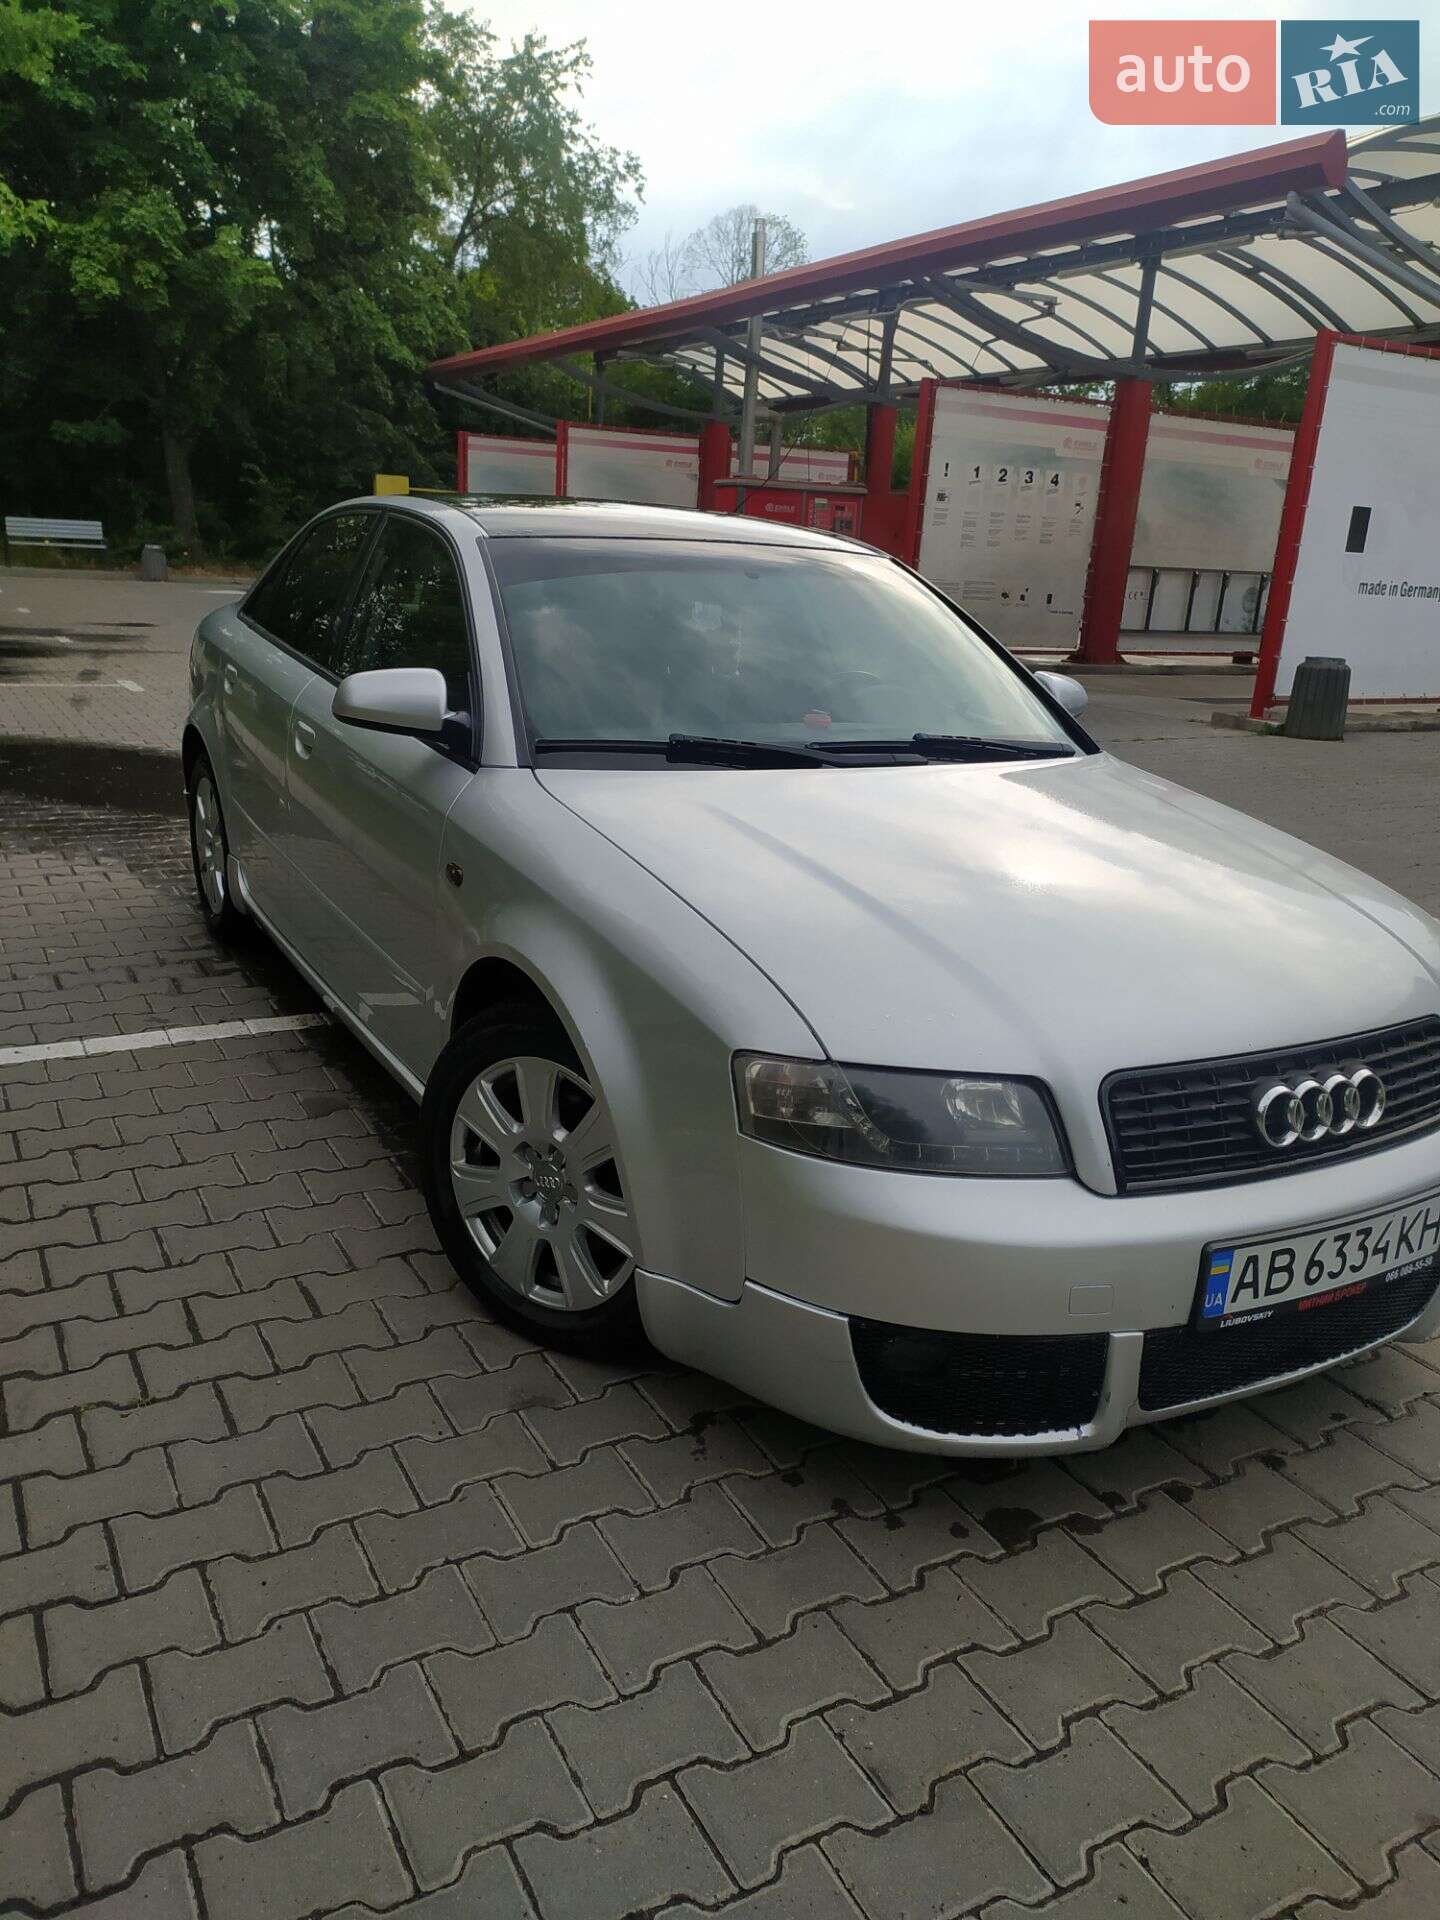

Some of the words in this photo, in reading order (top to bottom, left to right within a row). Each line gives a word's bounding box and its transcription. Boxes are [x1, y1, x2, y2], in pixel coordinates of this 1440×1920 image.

[973, 466, 981, 479] 1
[998, 468, 1008, 482] 2
[1024, 470, 1034, 484] 3
[1050, 473, 1059, 487] 4
[1358, 580, 1387, 596] made
[1388, 580, 1398, 597] in
[1231, 1247, 1296, 1304] AB
[1304, 1219, 1393, 1286] 6334
[1204, 1291, 1223, 1308] UA
